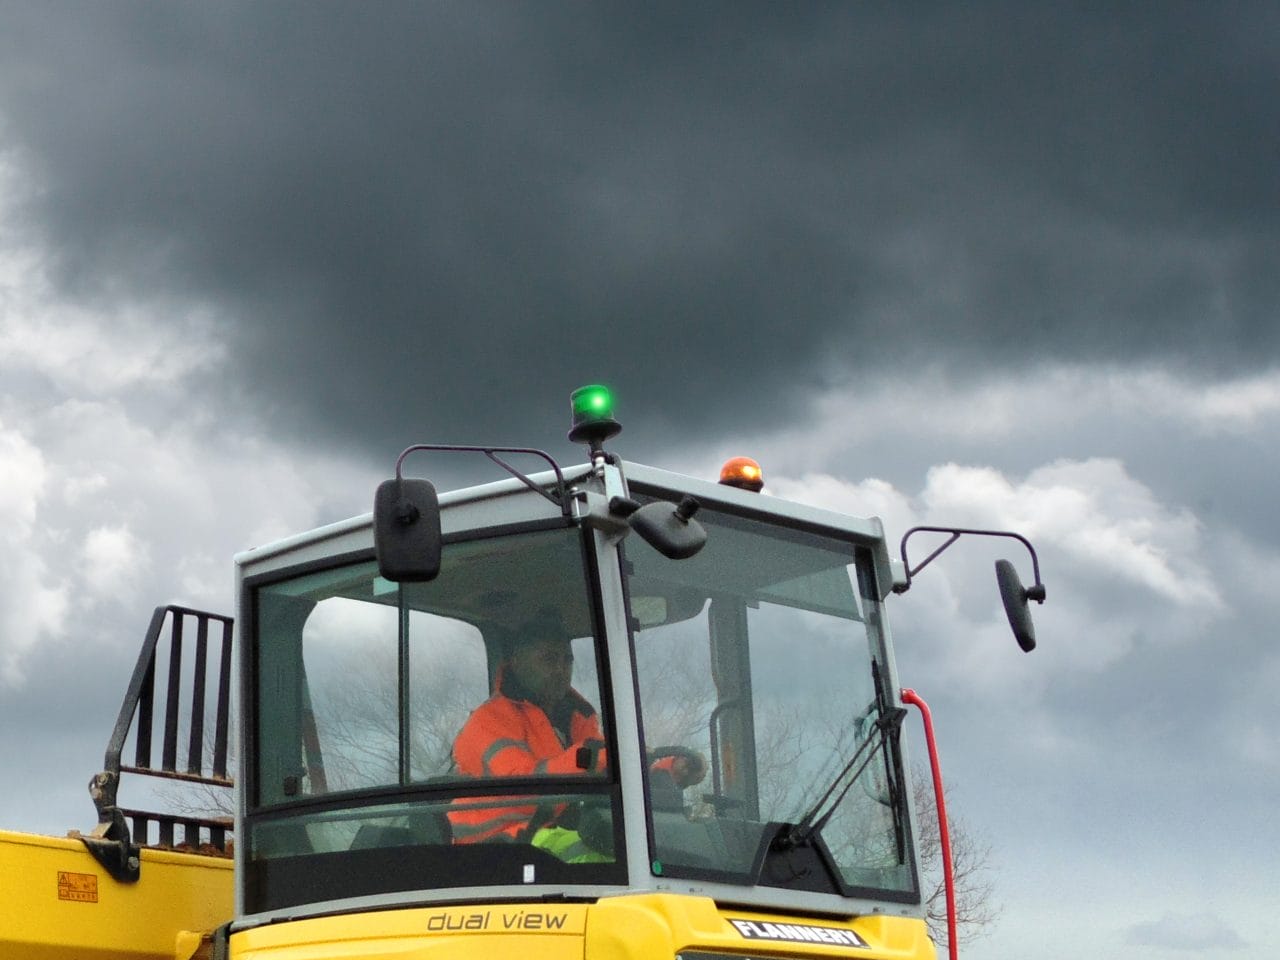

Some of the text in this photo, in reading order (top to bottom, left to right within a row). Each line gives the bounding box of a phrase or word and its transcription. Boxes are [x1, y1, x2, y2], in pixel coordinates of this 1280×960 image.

[427, 910, 568, 931] dual view
[731, 919, 861, 946] FLANNERY
